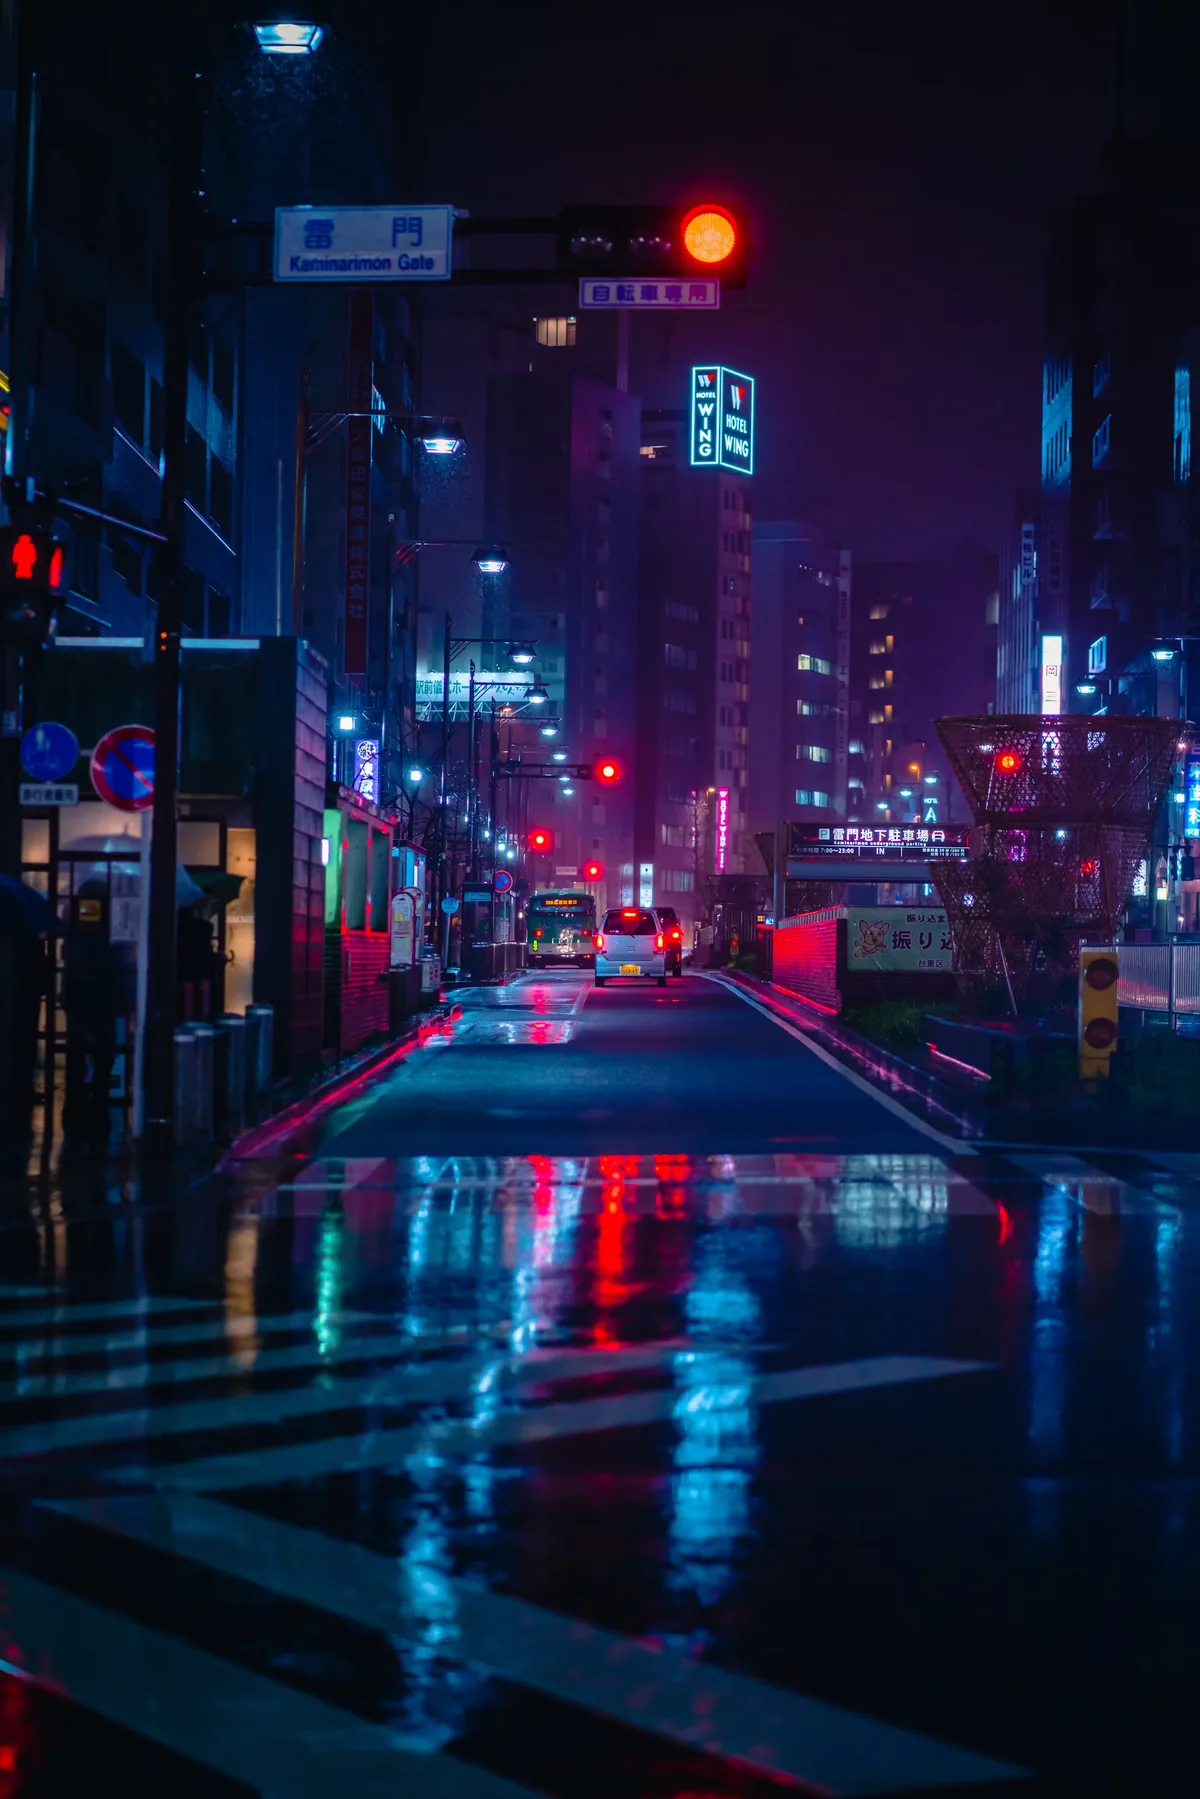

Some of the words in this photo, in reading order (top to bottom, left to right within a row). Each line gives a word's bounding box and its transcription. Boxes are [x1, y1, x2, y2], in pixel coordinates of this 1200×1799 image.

[304, 217, 423, 249] 雷門
[290, 255, 391, 272] Kaminarimon
[398, 253, 434, 271] Gate
[592, 285, 707, 302] 自転車専用
[697, 403, 715, 457] WING
[726, 413, 747, 434] HOTEL
[724, 433, 749, 458] WING
[718, 826, 727, 848] WING
[832, 828, 929, 842] 雷門地下駐車場
[876, 847, 885, 855] IN
[918, 959, 945, 968] 台東区
